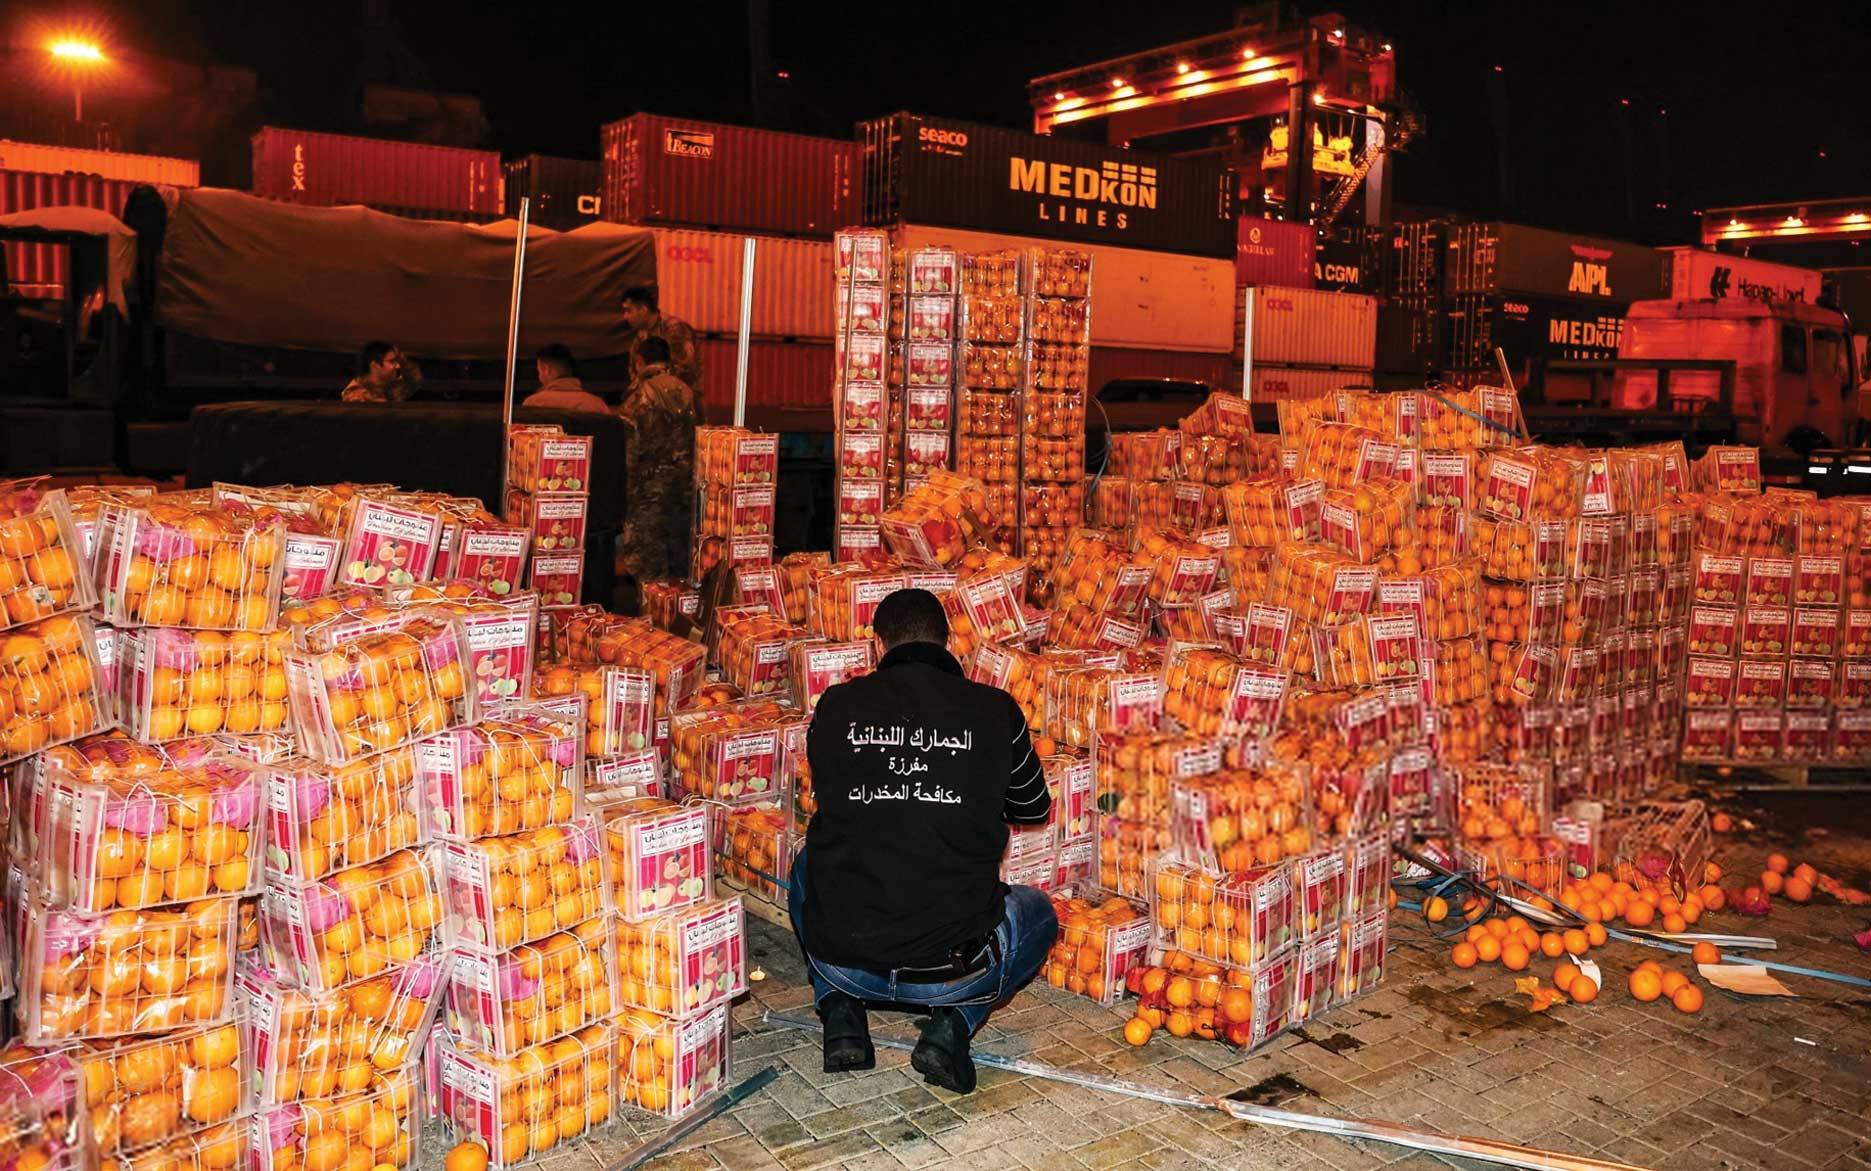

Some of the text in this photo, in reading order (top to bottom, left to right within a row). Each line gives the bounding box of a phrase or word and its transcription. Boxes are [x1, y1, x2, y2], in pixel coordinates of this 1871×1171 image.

[919, 127, 968, 147] seaco
[292, 143, 305, 191] tex
[1010, 157, 1156, 209] MEDKON
[1039, 202, 1128, 230] LINES
[1325, 264, 1359, 284] CGM
[1568, 262, 1612, 296] APL
[847, 722, 972, 756] الجمارك اللبنانية
[888, 756, 928, 776] مفرزة
[848, 782, 962, 805] مكافحة المخدرات
